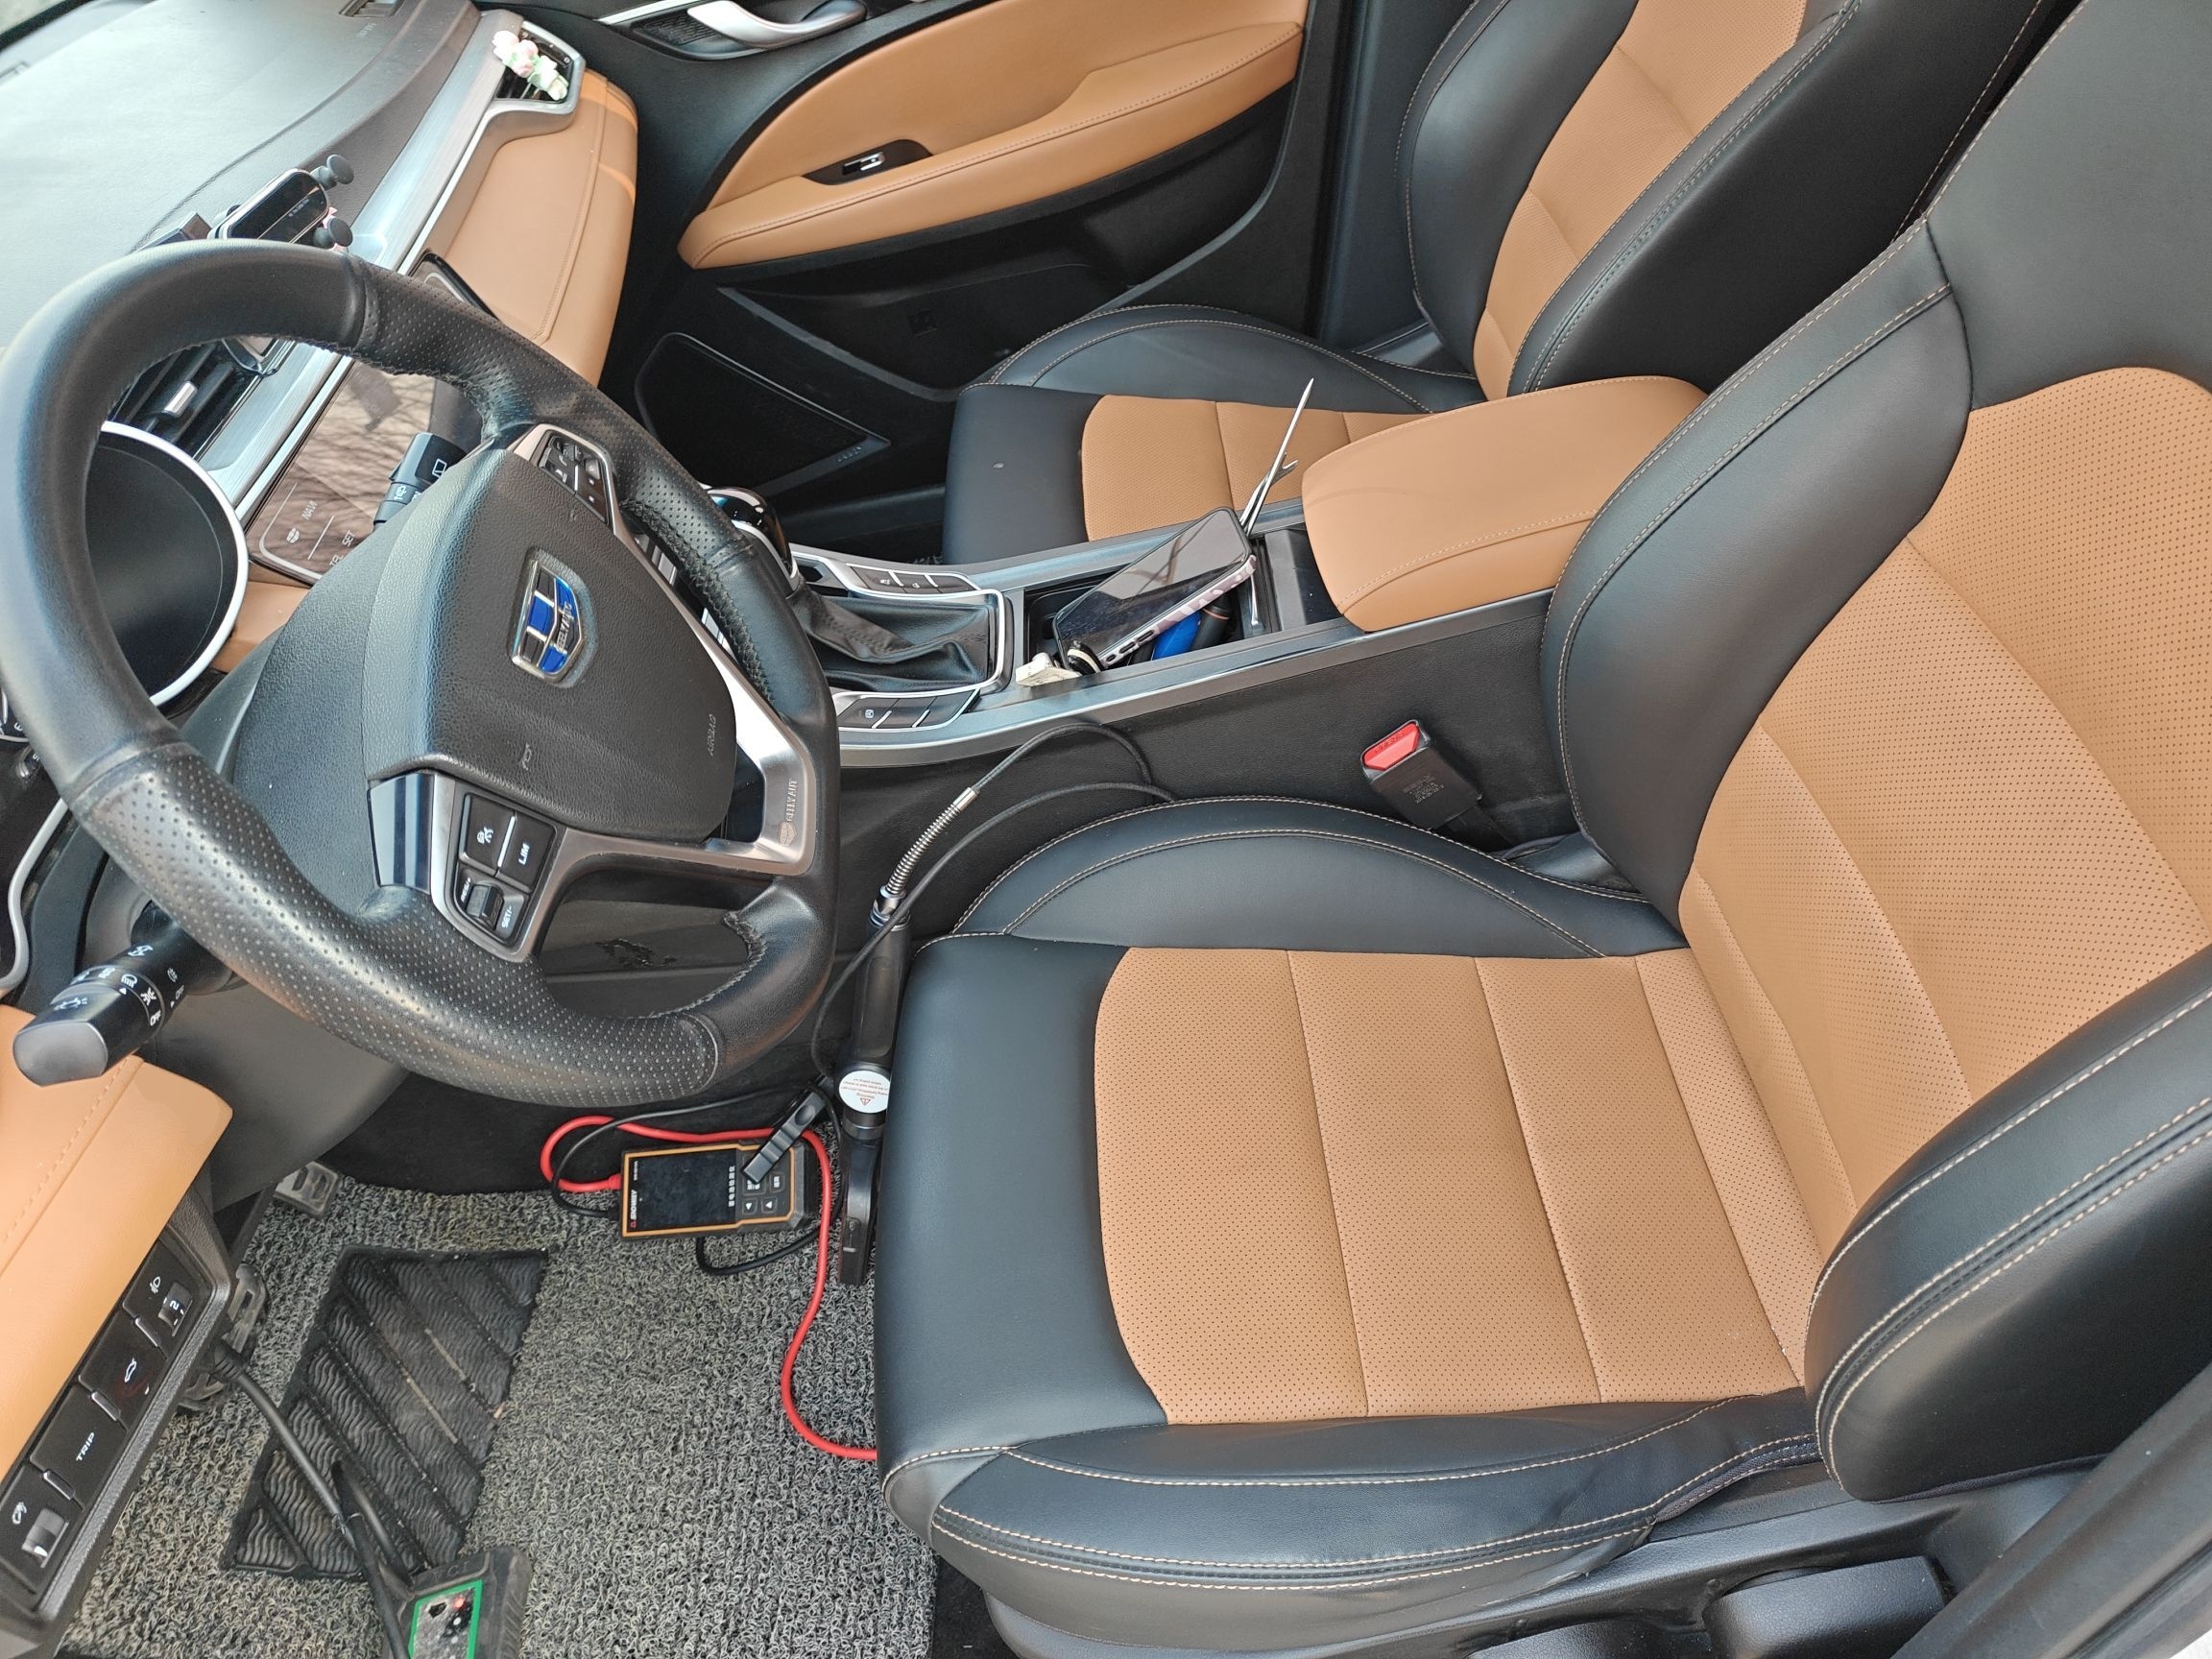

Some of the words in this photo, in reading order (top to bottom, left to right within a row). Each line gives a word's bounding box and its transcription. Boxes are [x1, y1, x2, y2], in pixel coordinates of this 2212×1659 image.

[301, 500, 318, 519] NAVI
[342, 529, 355, 547] SET
[708, 713, 716, 757] AIRBAG
[518, 843, 530, 865] LIM
[176, 985, 185, 1000] OFF
[150, 1010, 161, 1026] OFF
[76, 1432, 95, 1461] TRIP
